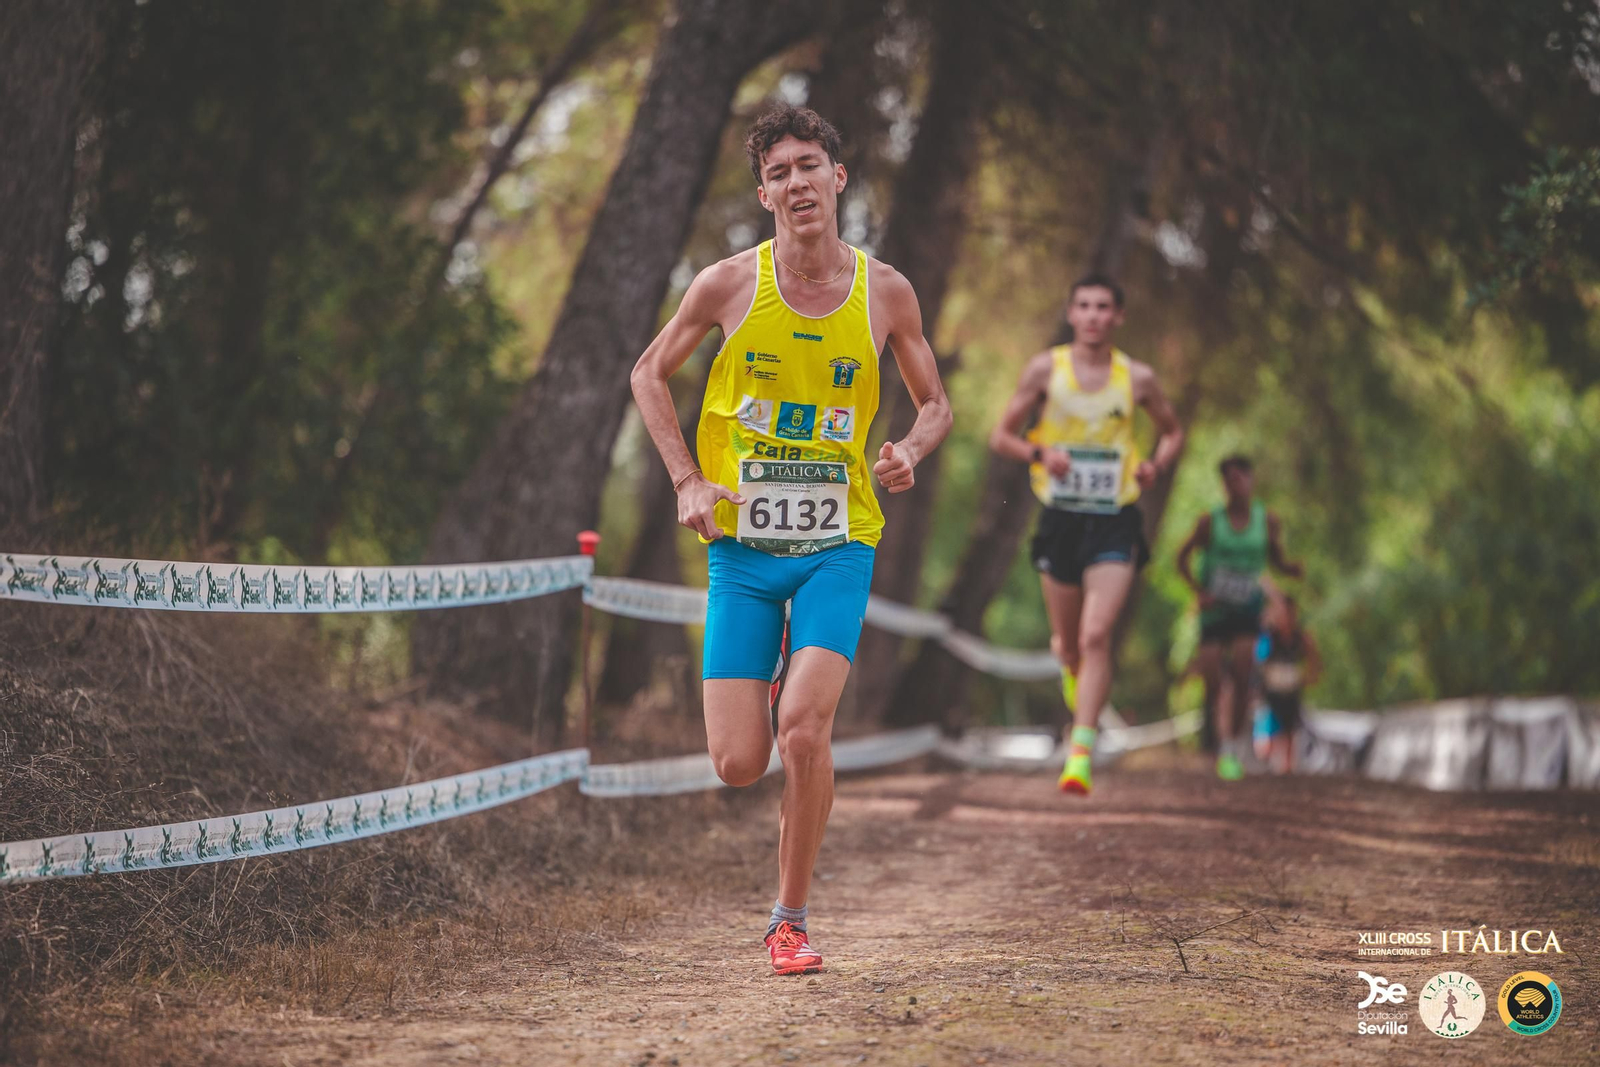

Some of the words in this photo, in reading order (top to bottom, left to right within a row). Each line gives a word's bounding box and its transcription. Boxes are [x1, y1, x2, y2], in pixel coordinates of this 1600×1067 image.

[782, 426, 800, 434] Cabildo
[771, 464, 822, 477] ITÁLICA
[750, 497, 840, 531] 6132
